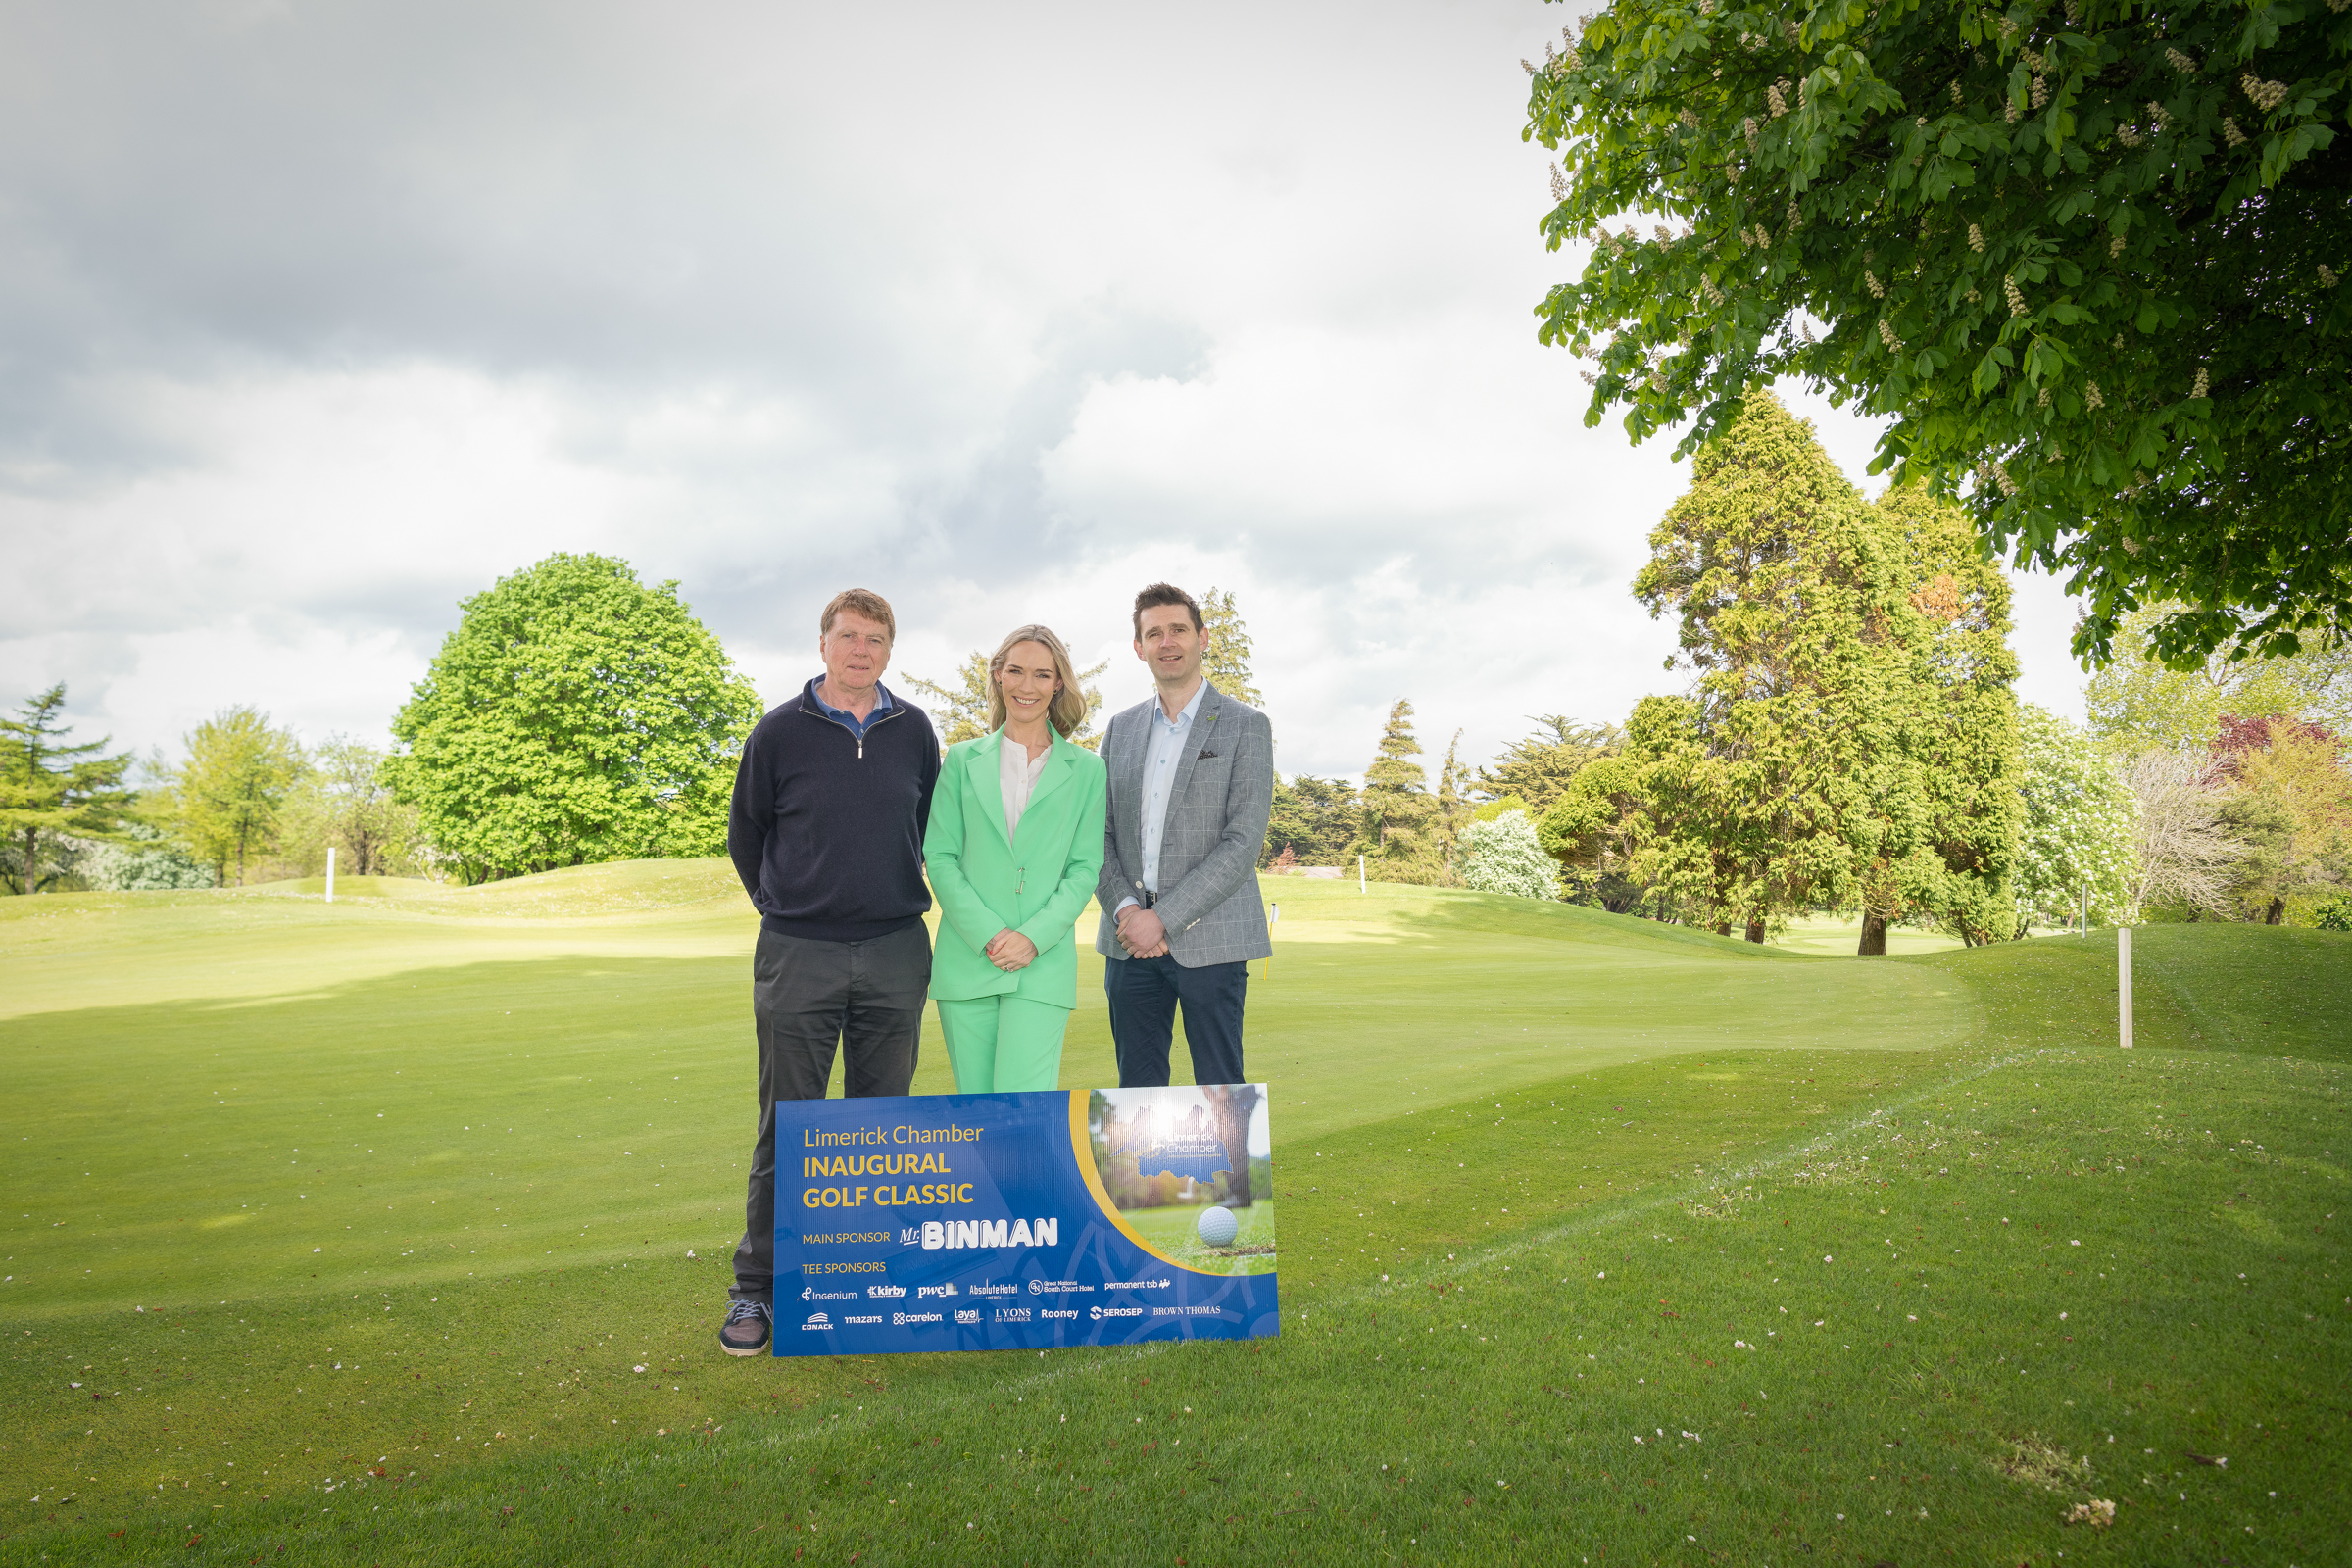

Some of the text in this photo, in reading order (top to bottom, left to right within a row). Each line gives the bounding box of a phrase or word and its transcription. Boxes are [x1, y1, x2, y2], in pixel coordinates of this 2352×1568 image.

[805, 1124, 984, 1147] Limerick Chamber
[1166, 1144, 1217, 1152] Chamber
[805, 1153, 951, 1177] INAUGURAL
[803, 1183, 973, 1208] GOLF CLASSIC
[804, 1232, 890, 1244] MAIN SPONSOR
[900, 1227, 919, 1245] Mr.
[922, 1218, 1057, 1250] BINMAN
[803, 1262, 886, 1274] TEE SPONSORS
[877, 1285, 906, 1298] kirby
[918, 1286, 945, 1298] pwc
[1105, 1281, 1145, 1291] permanent
[813, 1291, 857, 1299] Ingenium
[906, 1312, 942, 1322] carelon
[955, 1309, 975, 1320] laya
[996, 1307, 1031, 1317] LYONS
[1042, 1309, 1078, 1319] Rooney
